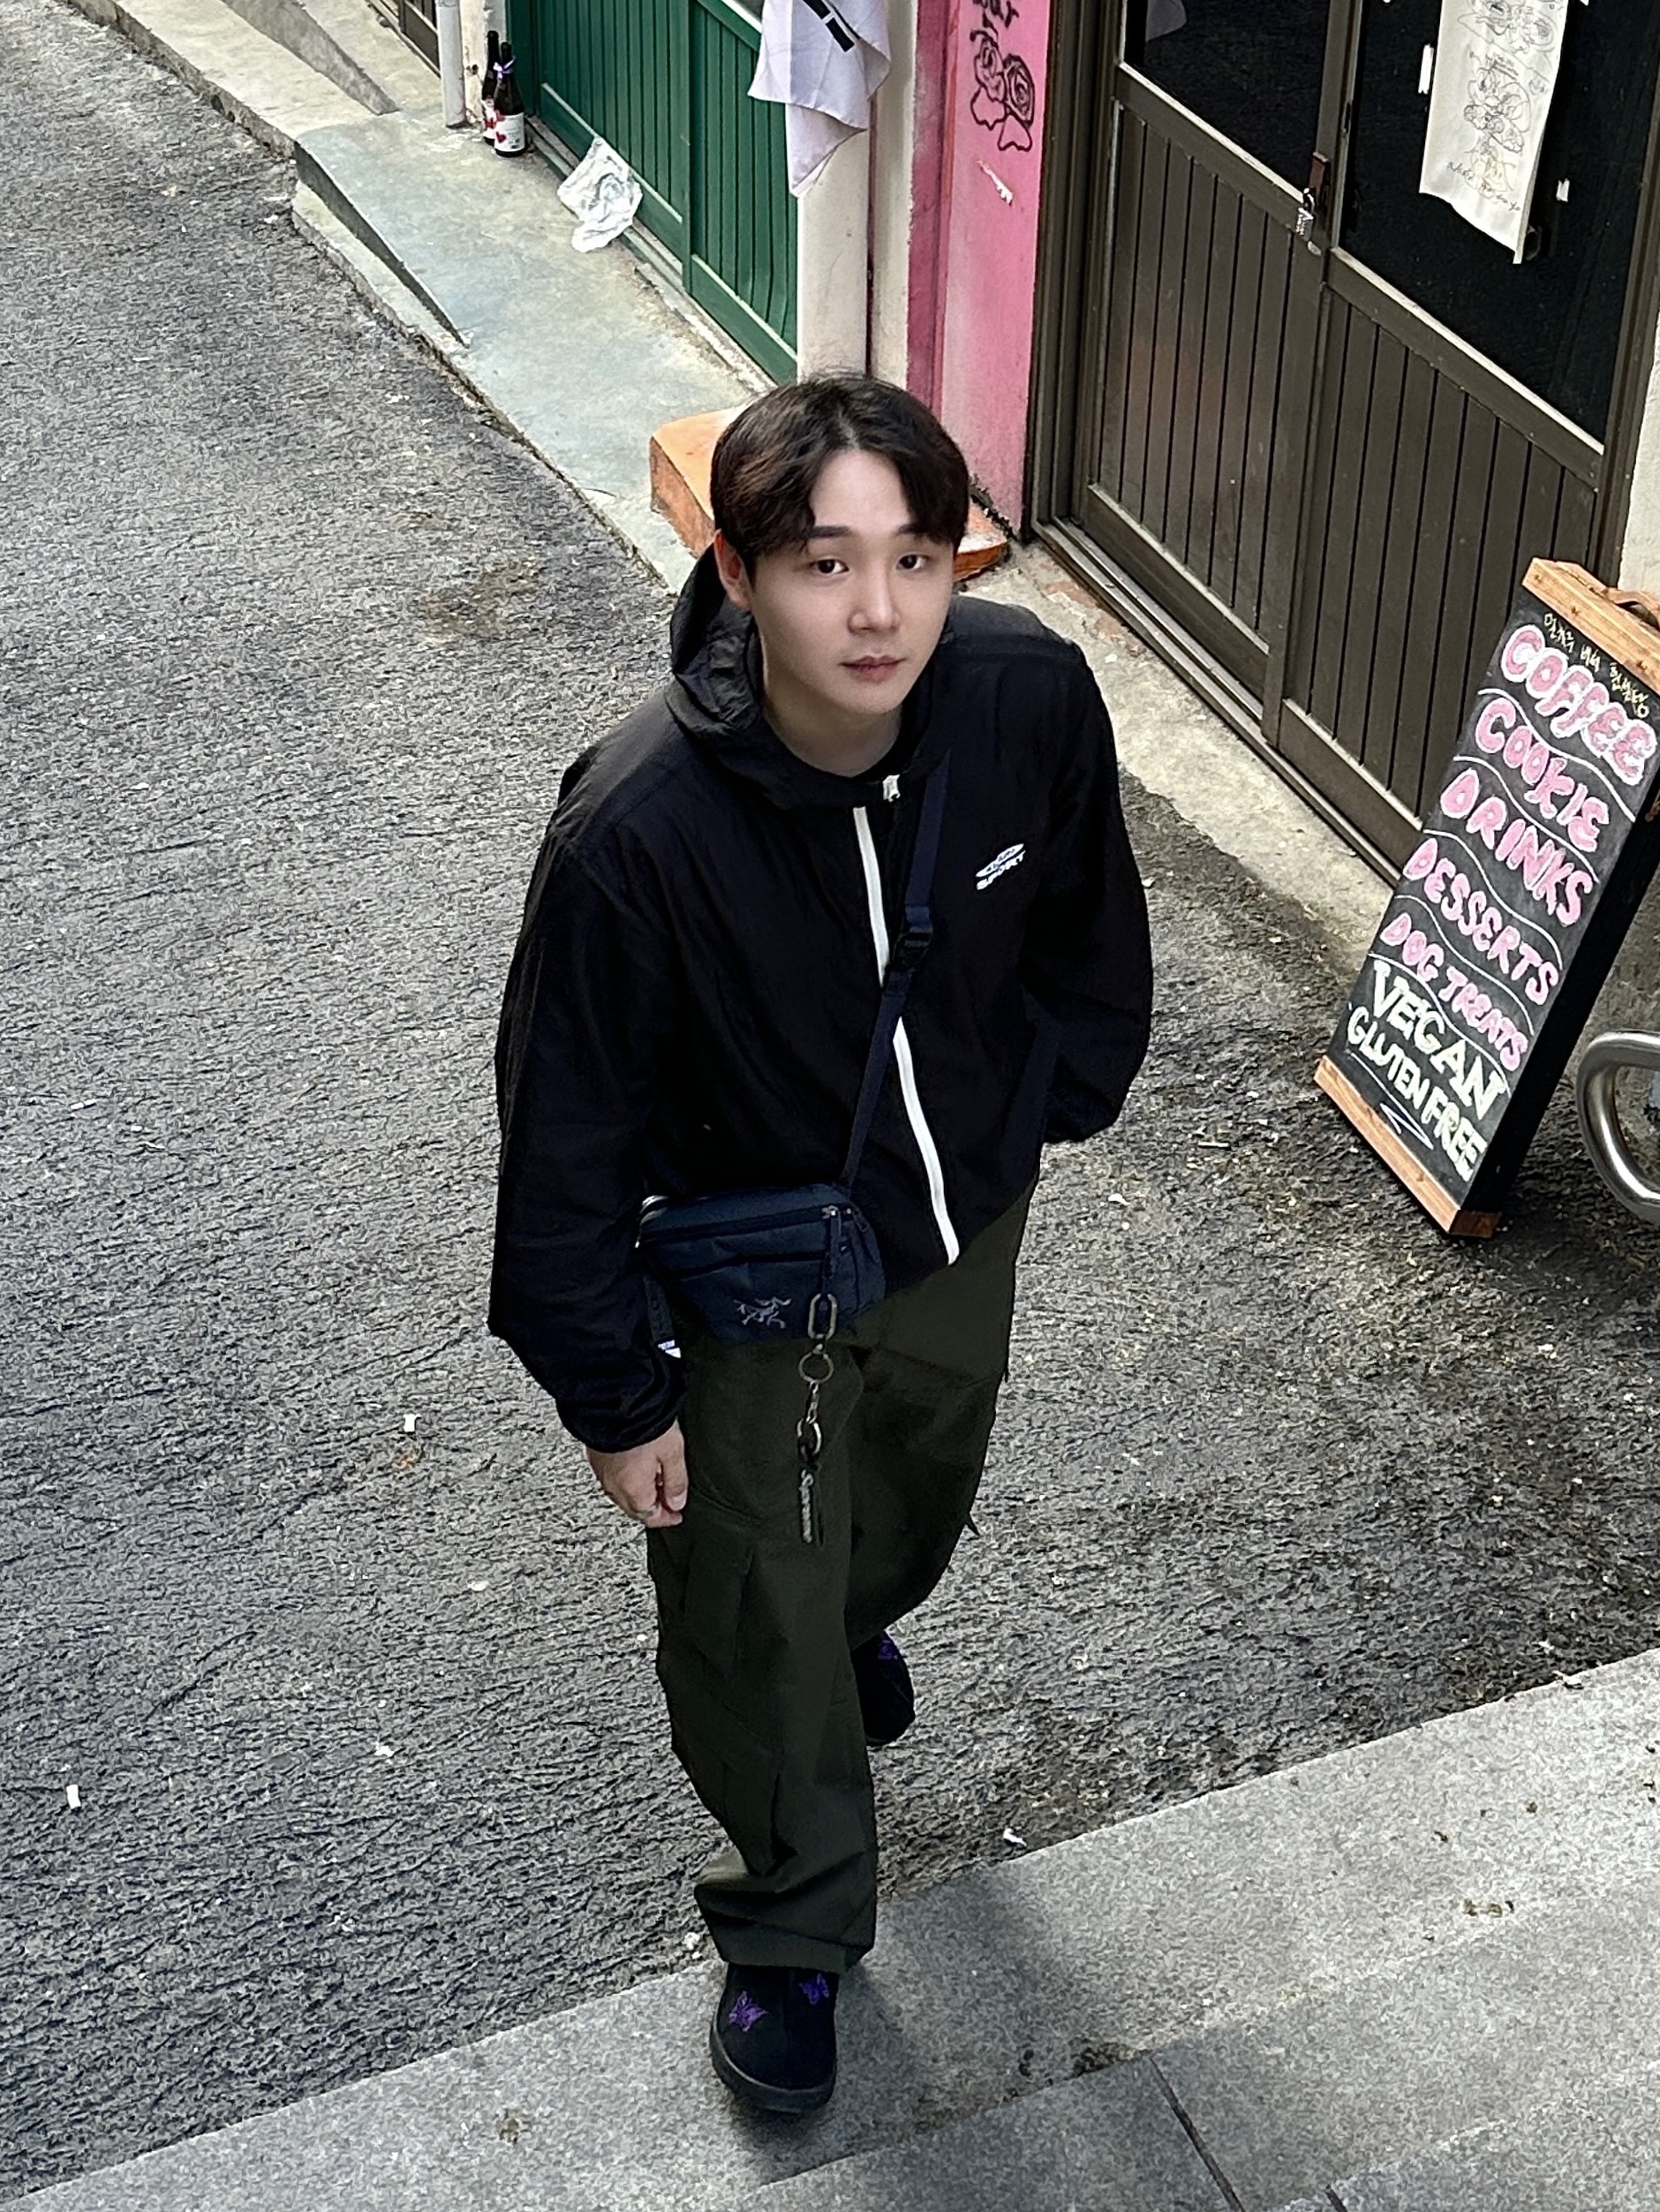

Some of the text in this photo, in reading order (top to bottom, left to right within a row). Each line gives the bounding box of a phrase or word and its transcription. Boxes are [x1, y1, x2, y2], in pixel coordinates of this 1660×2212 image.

[1475, 698, 1609, 852] COOKIE
[1501, 624, 1657, 786] COFFEE
[1402, 837, 1559, 1005] DESSERTS
[1440, 768, 1593, 926] DRINKS
[1374, 960, 1508, 1120] VEGAN
[1380, 912, 1528, 1071] DOG TREATS
[1347, 1006, 1489, 1182] GLUTEN FREE
